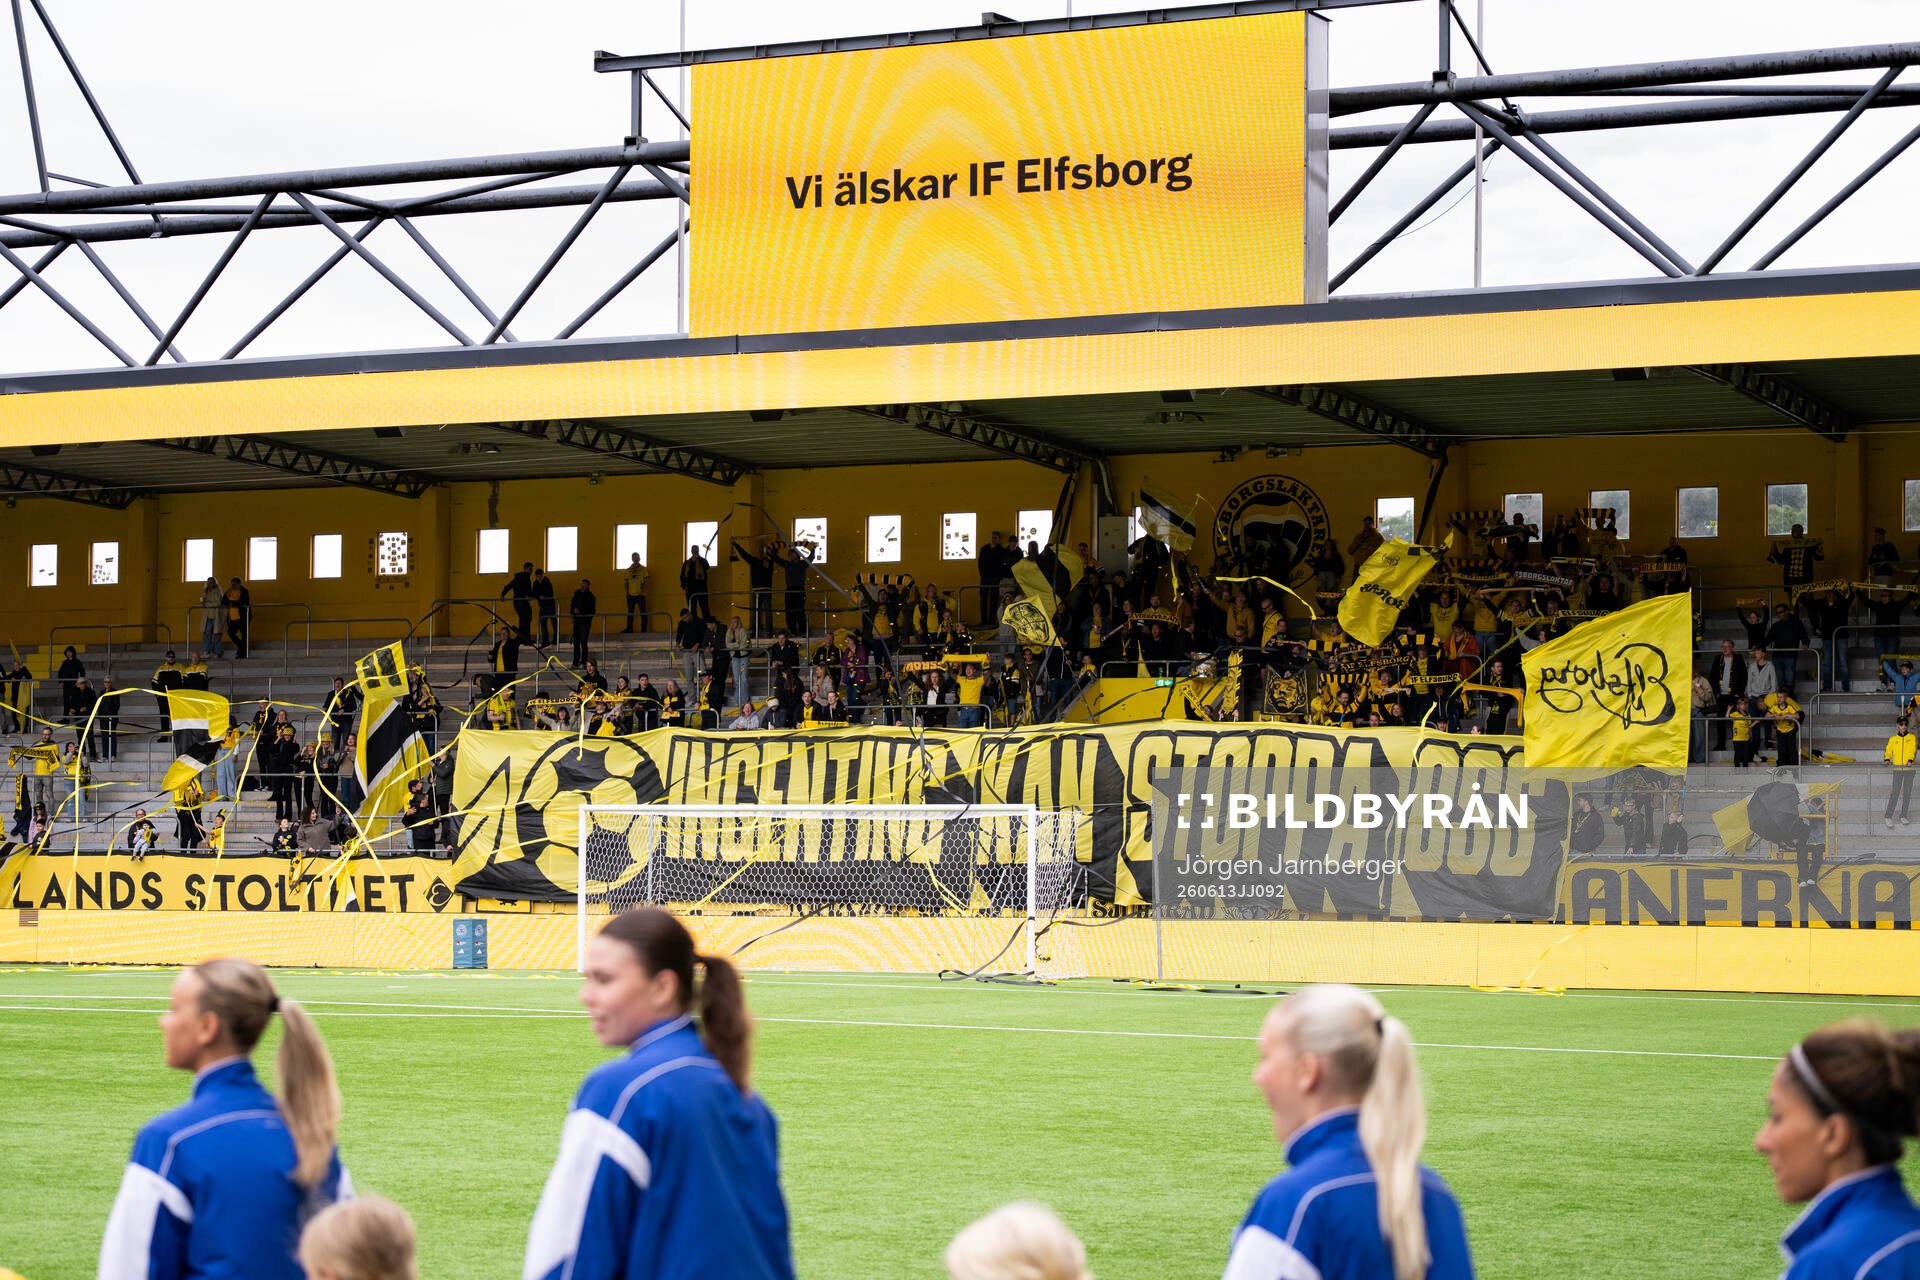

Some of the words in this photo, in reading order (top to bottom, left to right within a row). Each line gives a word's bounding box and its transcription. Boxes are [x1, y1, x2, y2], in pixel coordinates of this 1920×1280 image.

[786, 174, 823, 209] Vi
[834, 168, 958, 207] älskar
[969, 160, 1005, 197] IF
[1017, 153, 1193, 193] Elfsborg
[970, 733, 1102, 865] KAN
[1126, 730, 1374, 866] STOPPA
[1402, 738, 1538, 877] OSS
[14, 871, 163, 910] LANDS
